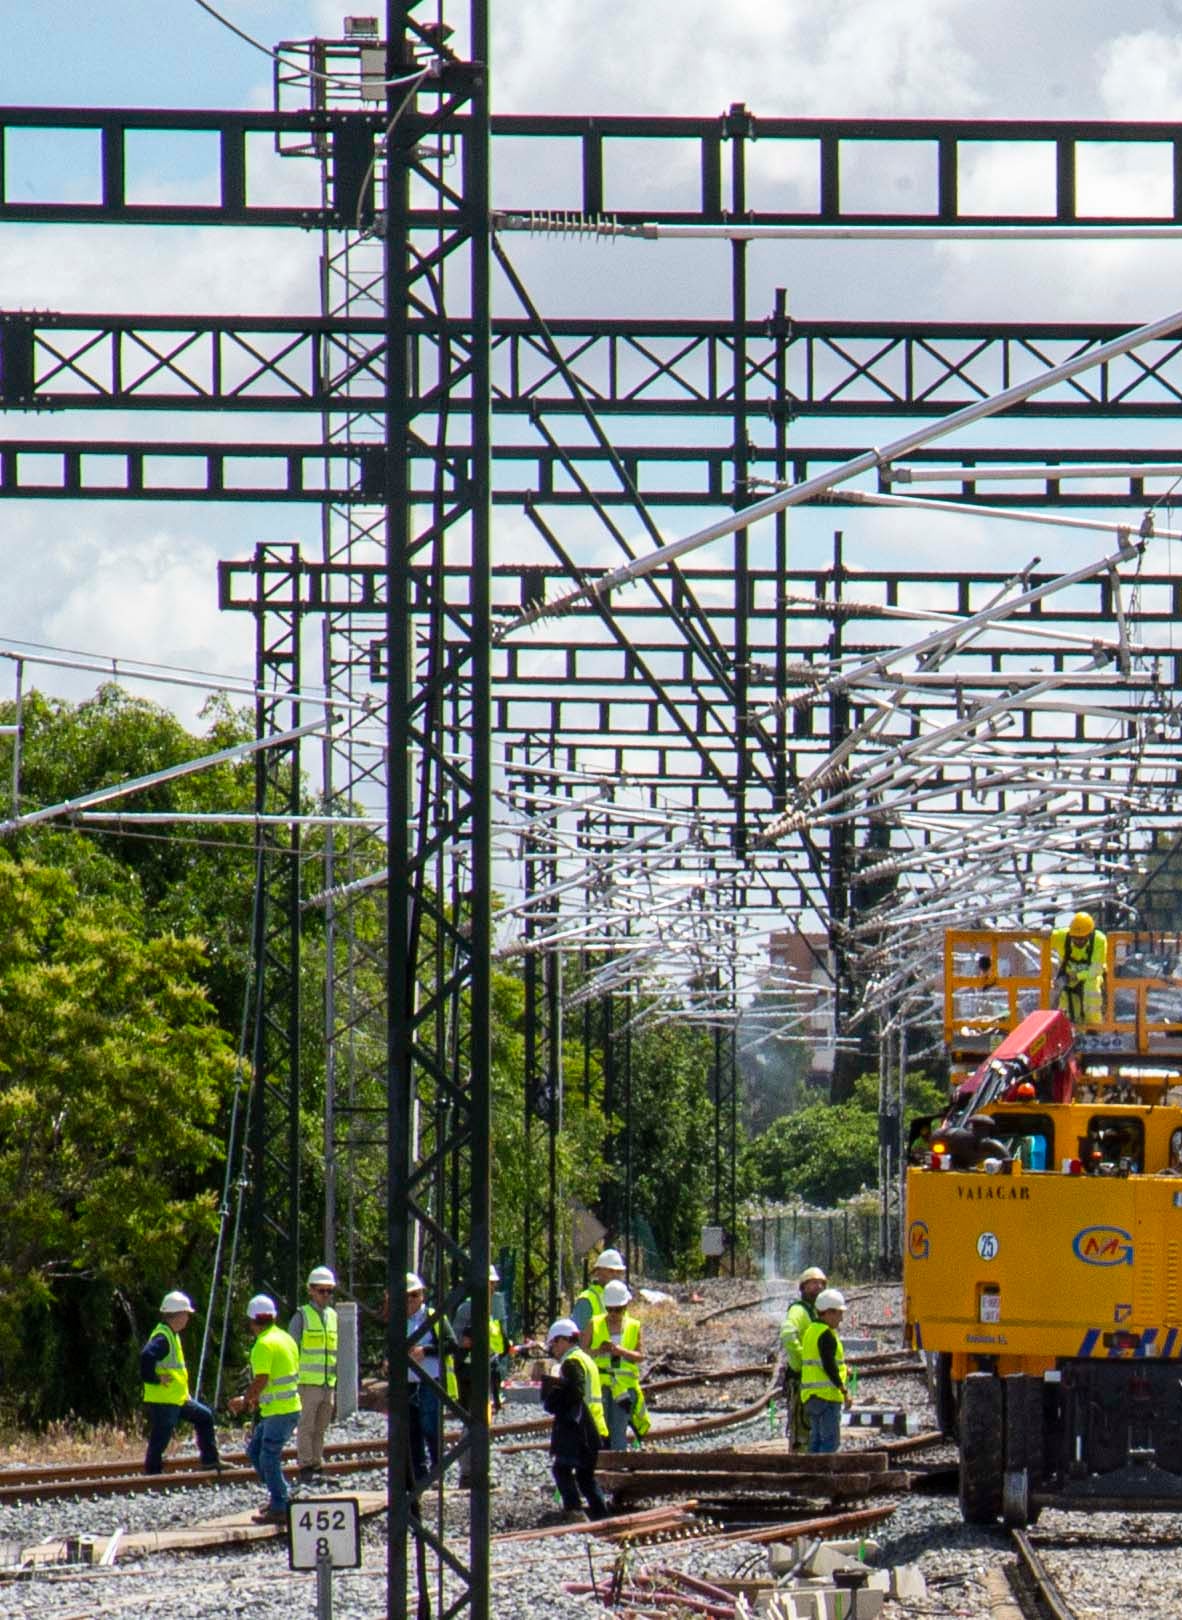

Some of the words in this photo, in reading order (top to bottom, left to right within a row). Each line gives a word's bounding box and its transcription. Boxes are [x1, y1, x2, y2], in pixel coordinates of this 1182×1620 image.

[981, 1234, 994, 1258] 25
[299, 1509, 346, 1532] 452
[315, 1536, 330, 1558] 8
